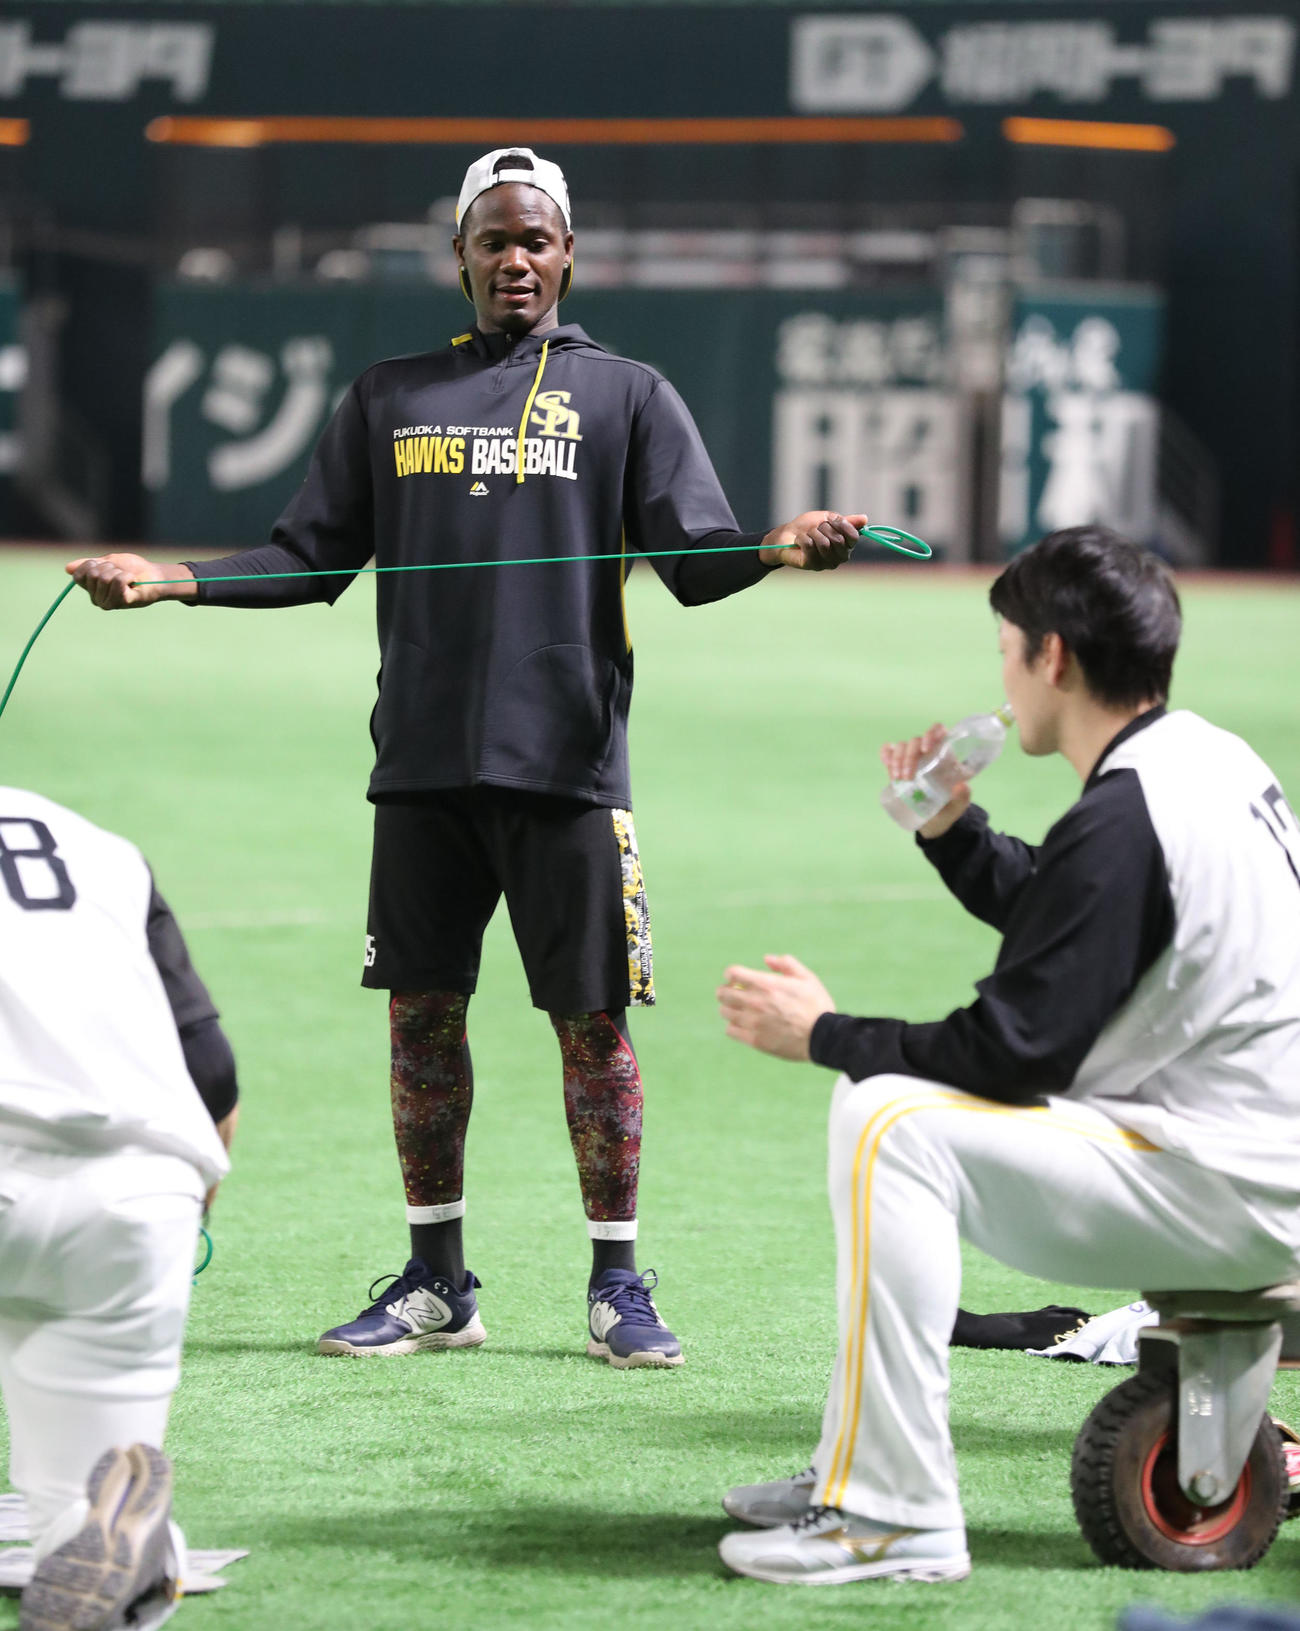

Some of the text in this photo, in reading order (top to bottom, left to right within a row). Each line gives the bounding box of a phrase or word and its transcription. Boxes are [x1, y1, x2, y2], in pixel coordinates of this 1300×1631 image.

[393, 425, 514, 439] FUKUOKA SOFTBANK
[394, 437, 577, 481] HAWKS BASEBALL
